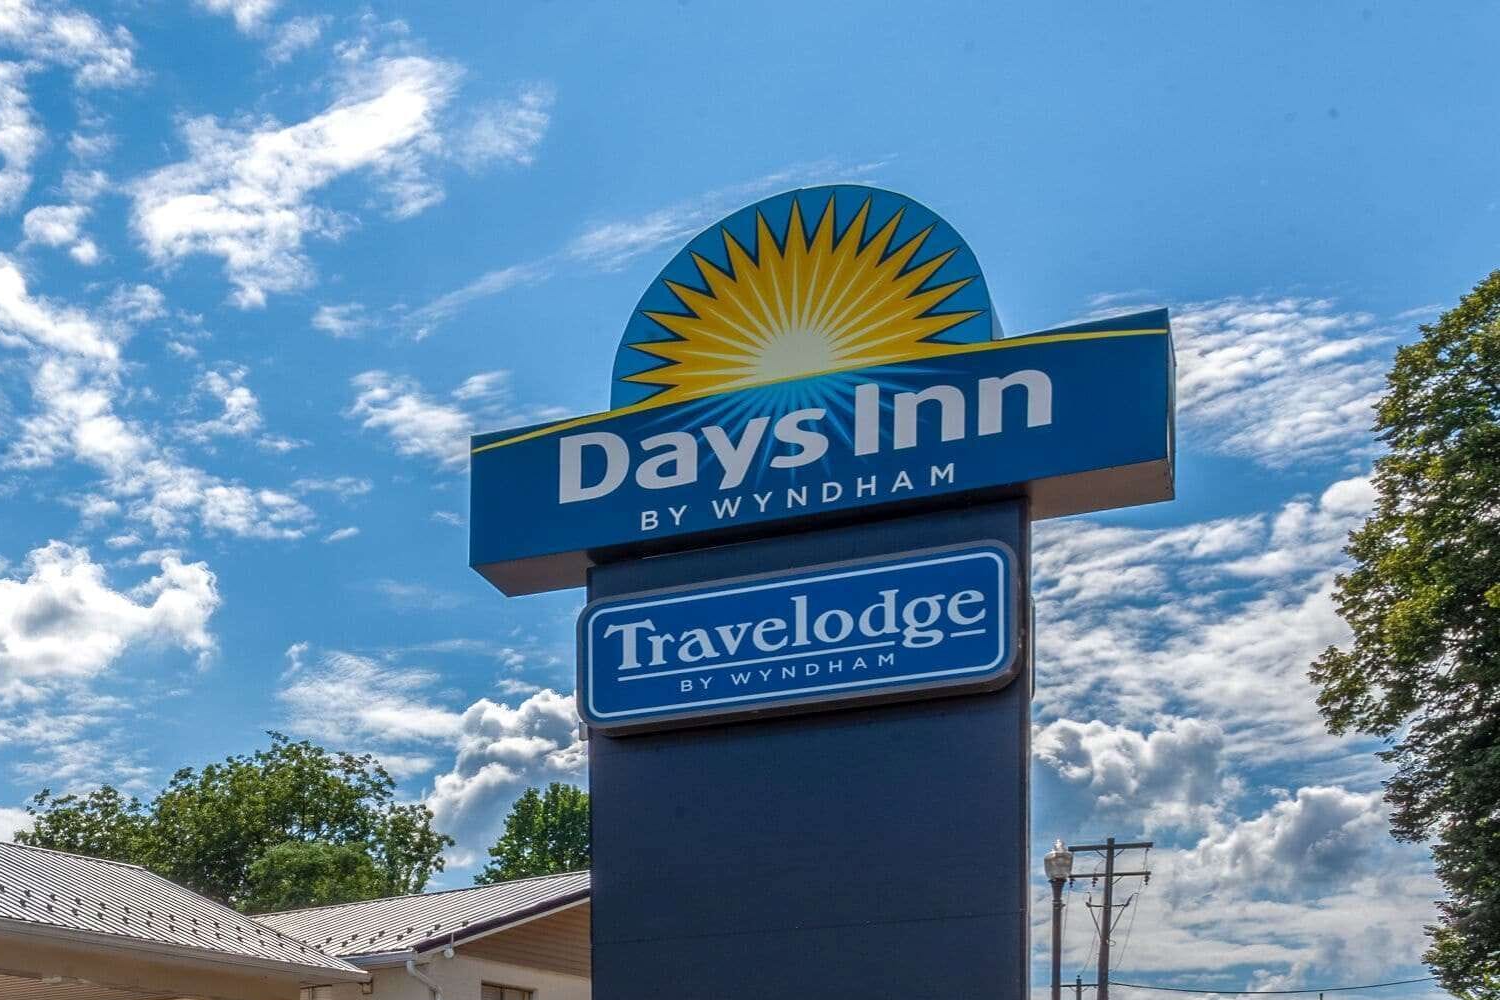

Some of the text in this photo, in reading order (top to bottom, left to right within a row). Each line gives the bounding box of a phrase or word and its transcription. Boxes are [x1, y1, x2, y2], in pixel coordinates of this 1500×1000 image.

[558, 369, 1053, 505] Days Inn
[640, 463, 955, 531] BY WYNDHAM
[603, 588, 987, 671] Travelodge
[680, 652, 895, 693] BY WYNDHAM
